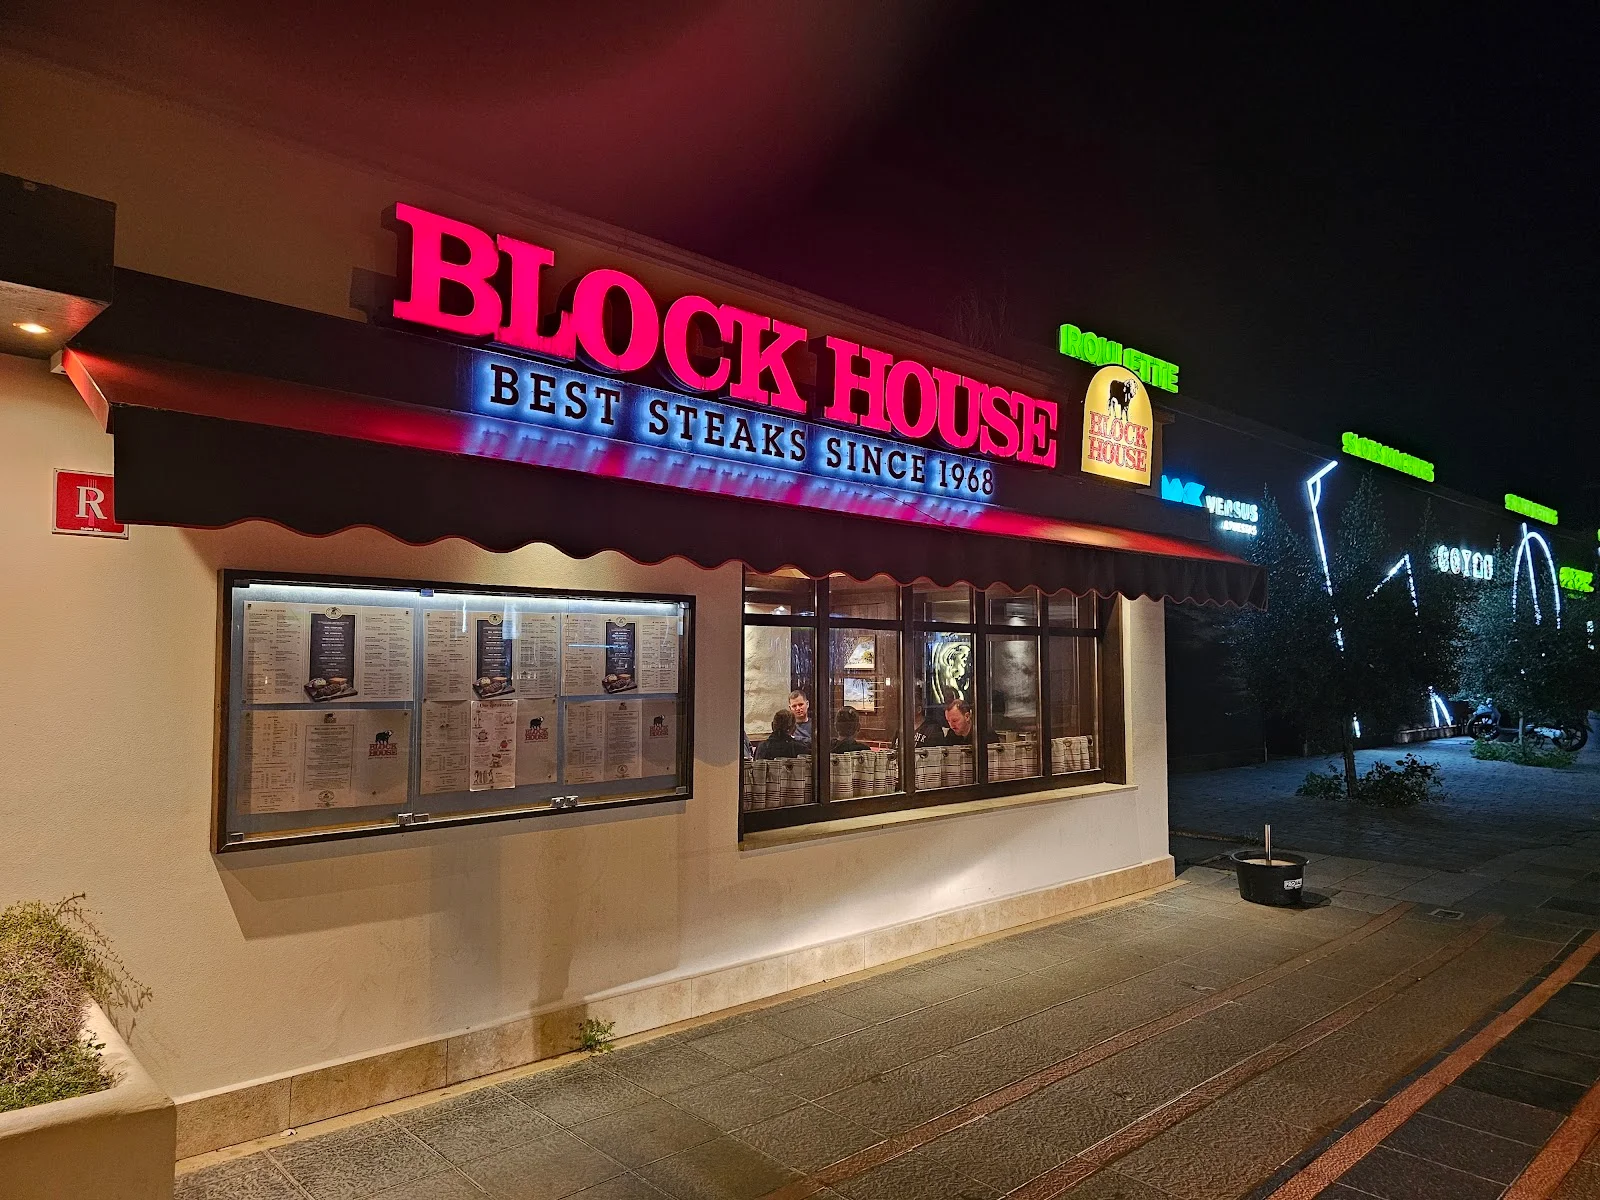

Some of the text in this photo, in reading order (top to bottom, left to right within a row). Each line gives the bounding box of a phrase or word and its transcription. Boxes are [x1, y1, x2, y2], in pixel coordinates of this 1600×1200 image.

[393, 202, 1058, 469] BLOCK HOUSE
[1060, 324, 1179, 393] ROULETTE
[490, 364, 993, 495] BEST STEAKS SINCE 1968
[1089, 411, 1148, 449] BLOCK
[1088, 436, 1148, 472] HOUSE
[75, 486, 107, 519] R
[1205, 495, 1258, 522] VERSUS
